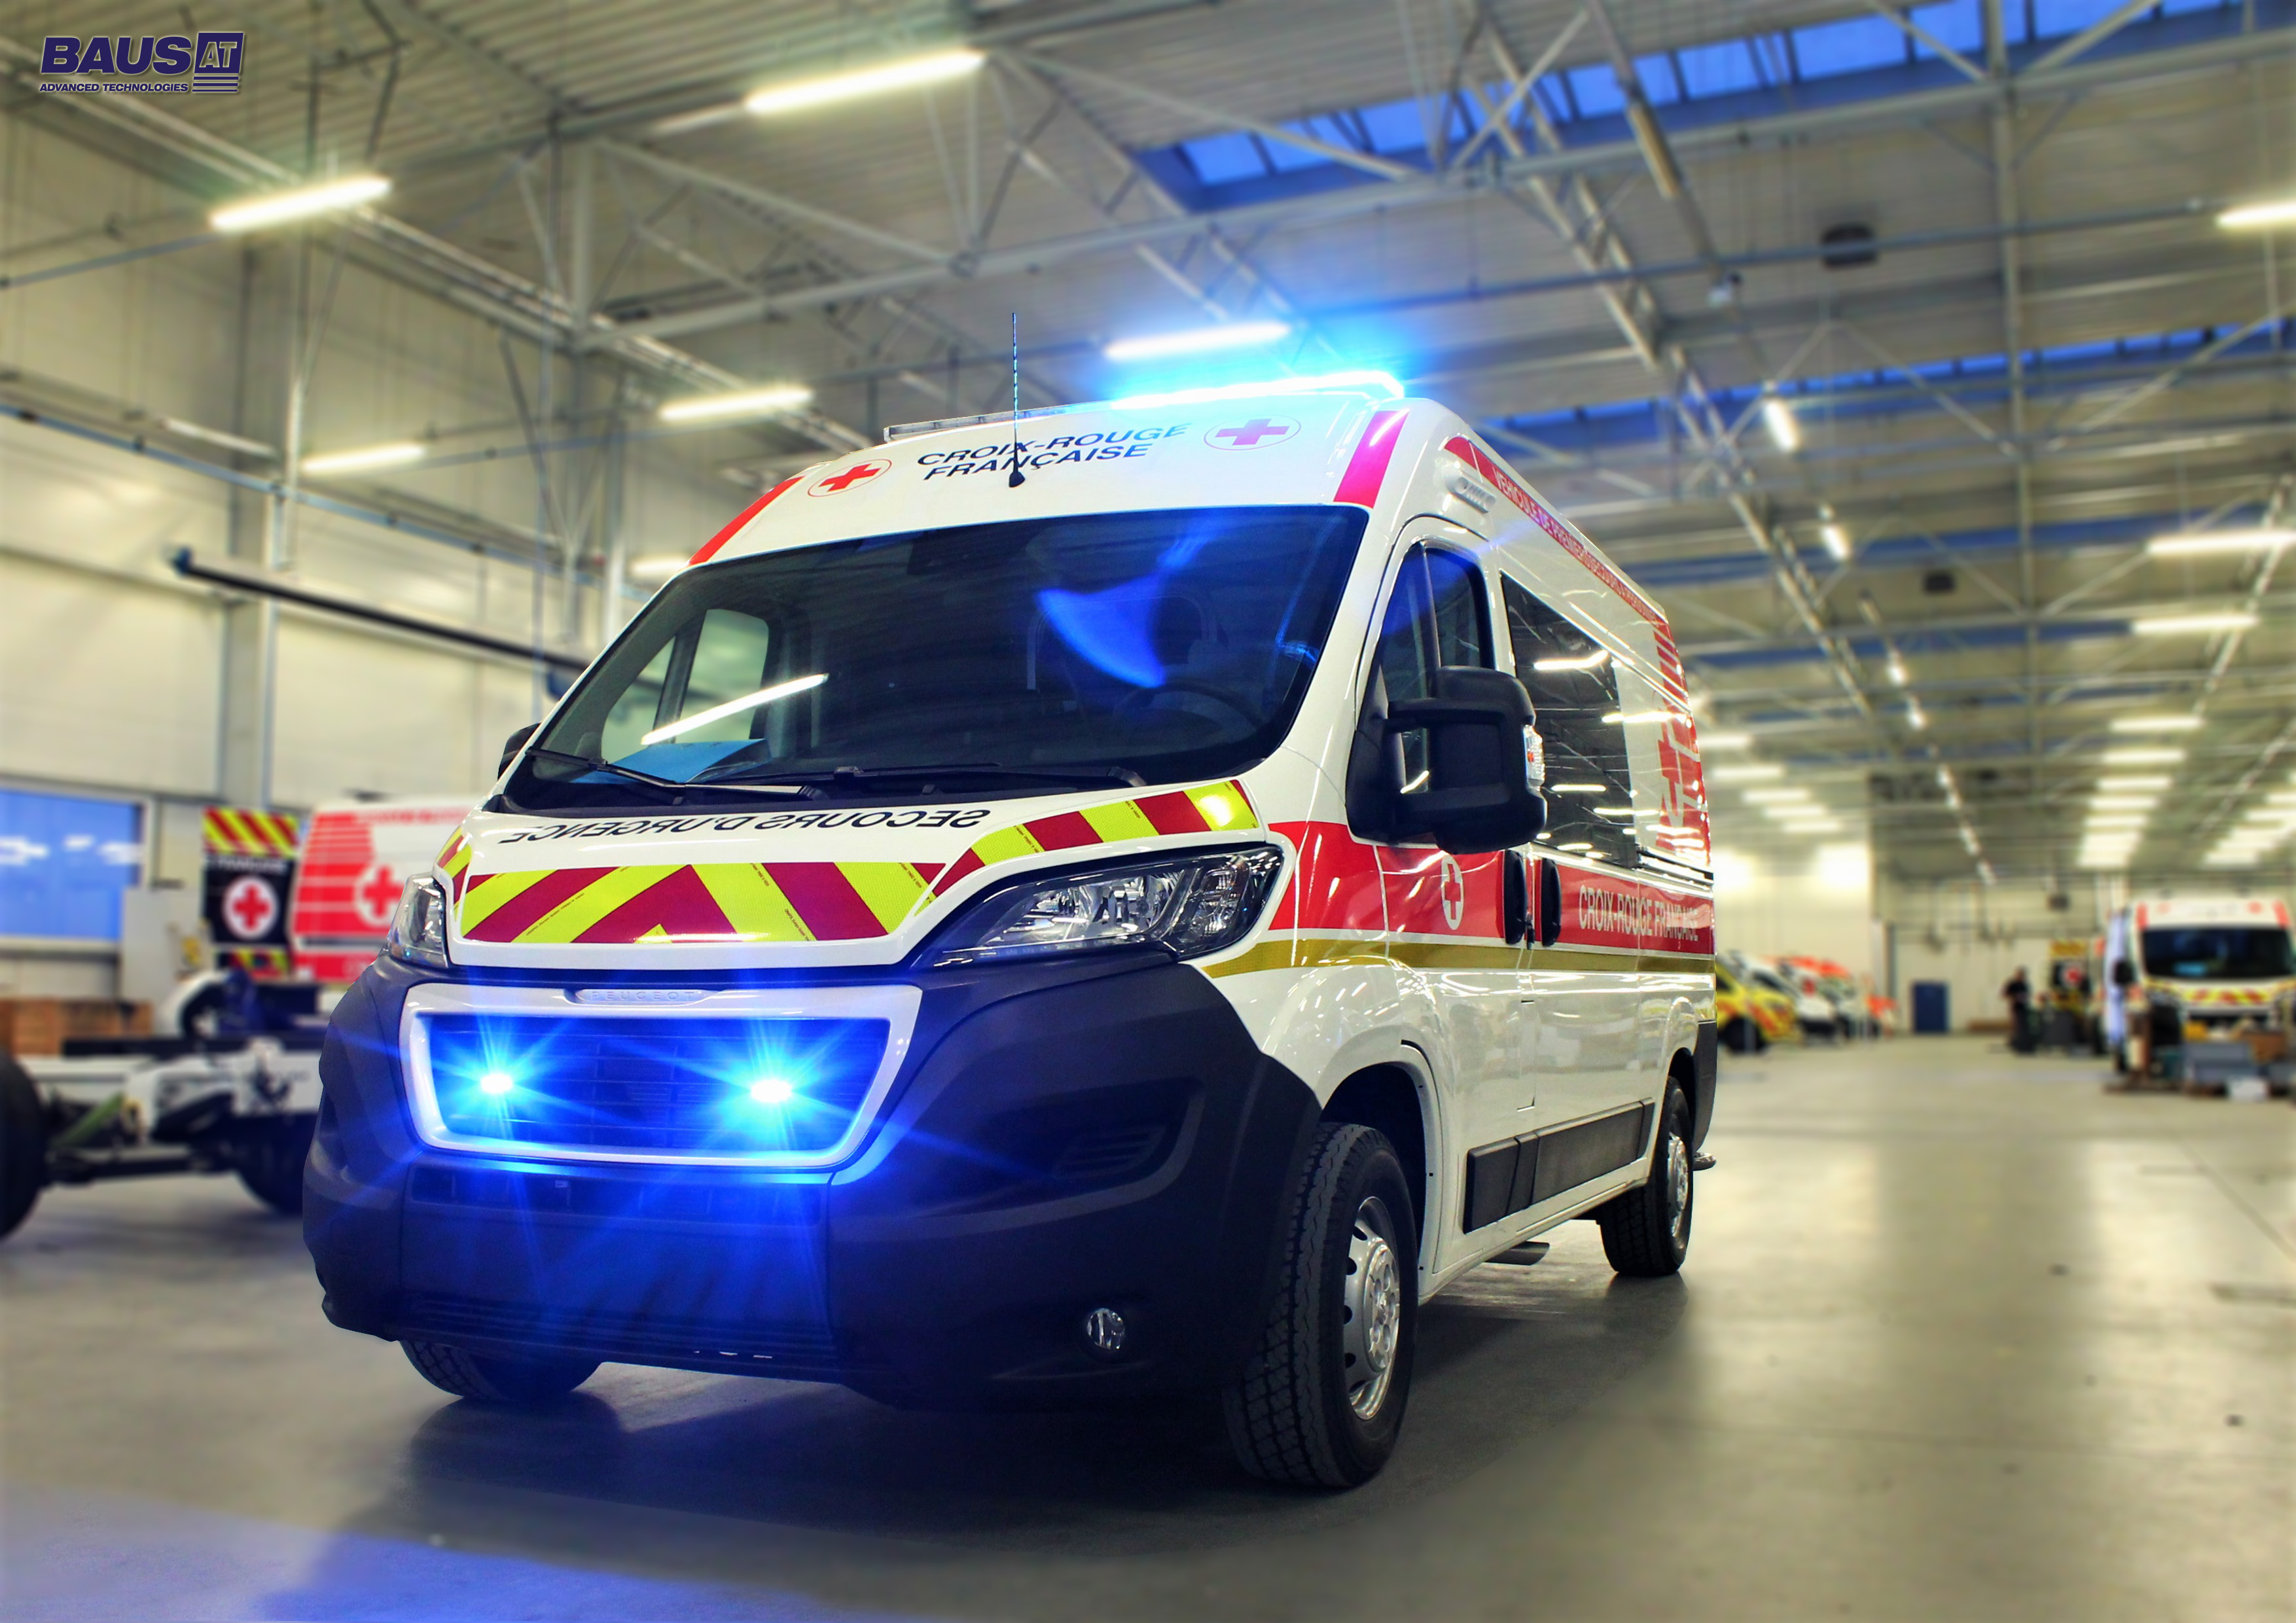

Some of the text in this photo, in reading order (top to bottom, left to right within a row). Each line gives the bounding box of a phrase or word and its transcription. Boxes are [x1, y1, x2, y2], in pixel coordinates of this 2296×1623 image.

[917, 422, 1193, 466] CROIX-ROUGE
[923, 442, 1154, 481] FRANÇAISE
[1579, 885, 1653, 936] CROIX-ROUGE
[591, 991, 695, 1000] PEUGEOT
